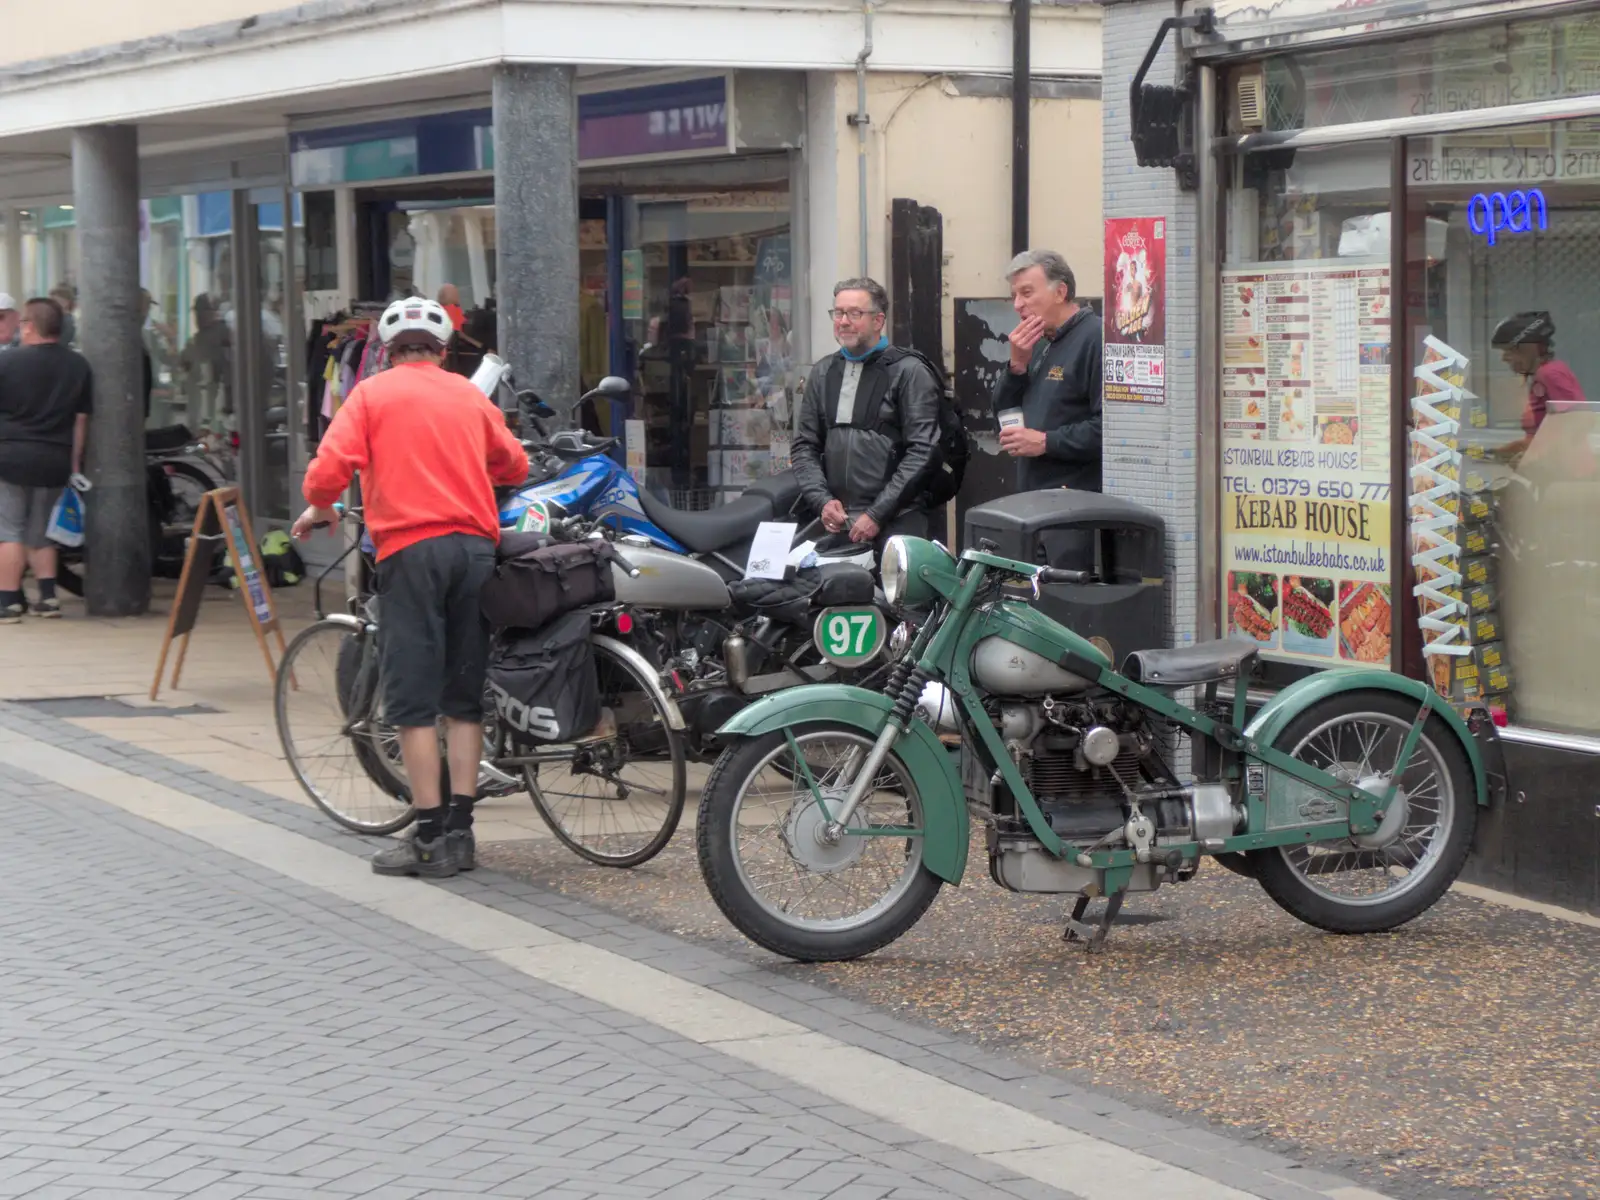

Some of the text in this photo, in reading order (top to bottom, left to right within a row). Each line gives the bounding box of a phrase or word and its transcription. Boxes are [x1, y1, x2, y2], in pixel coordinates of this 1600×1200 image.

[1467, 188, 1548, 246] open
[1277, 449, 1315, 468] KEBAB
[1318, 451, 1359, 470] HOUSE
[1223, 476, 1391, 500] TEL: 01379 650 777
[1234, 540, 1386, 572] www.istanbulkebabs.co.uk
[829, 615, 873, 655] 97
